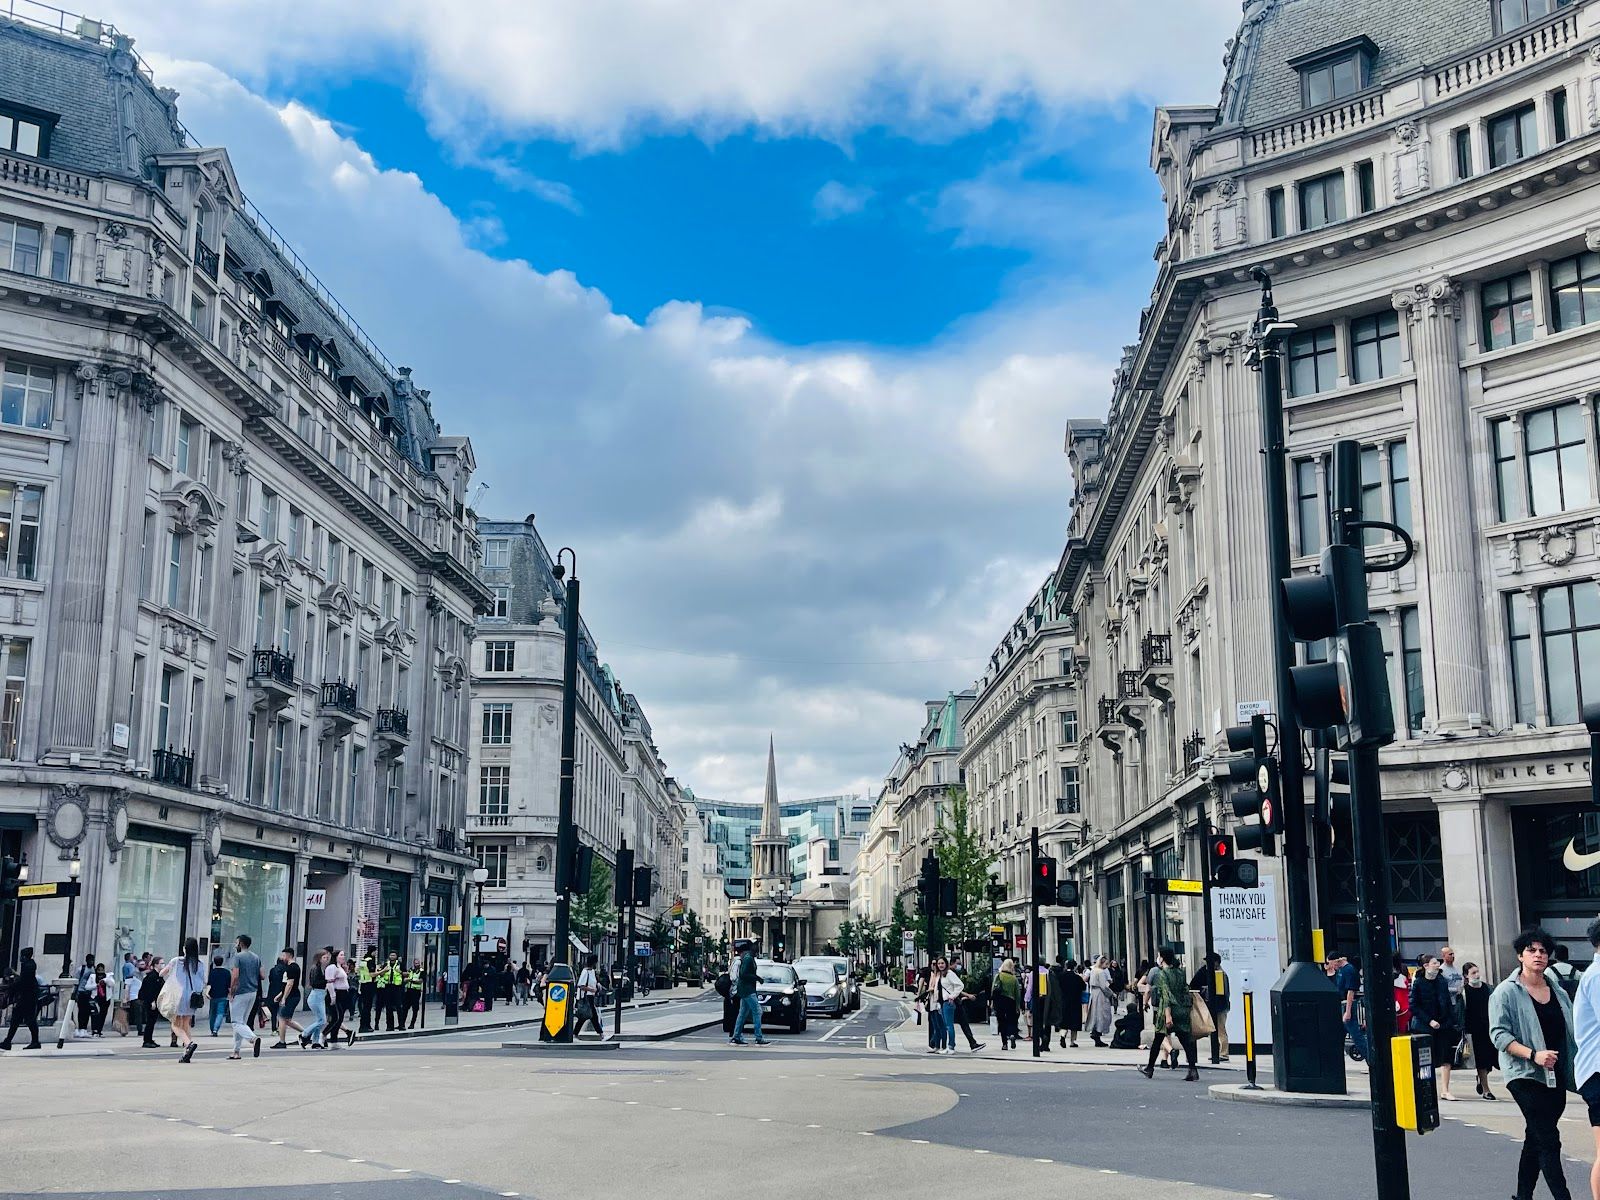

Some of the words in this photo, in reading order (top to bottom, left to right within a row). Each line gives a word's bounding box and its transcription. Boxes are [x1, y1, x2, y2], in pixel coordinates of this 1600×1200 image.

[1218, 893, 1247, 905] THANK
[1249, 893, 1266, 905] YOU
[1219, 908, 1266, 920] #STAYSAFE
